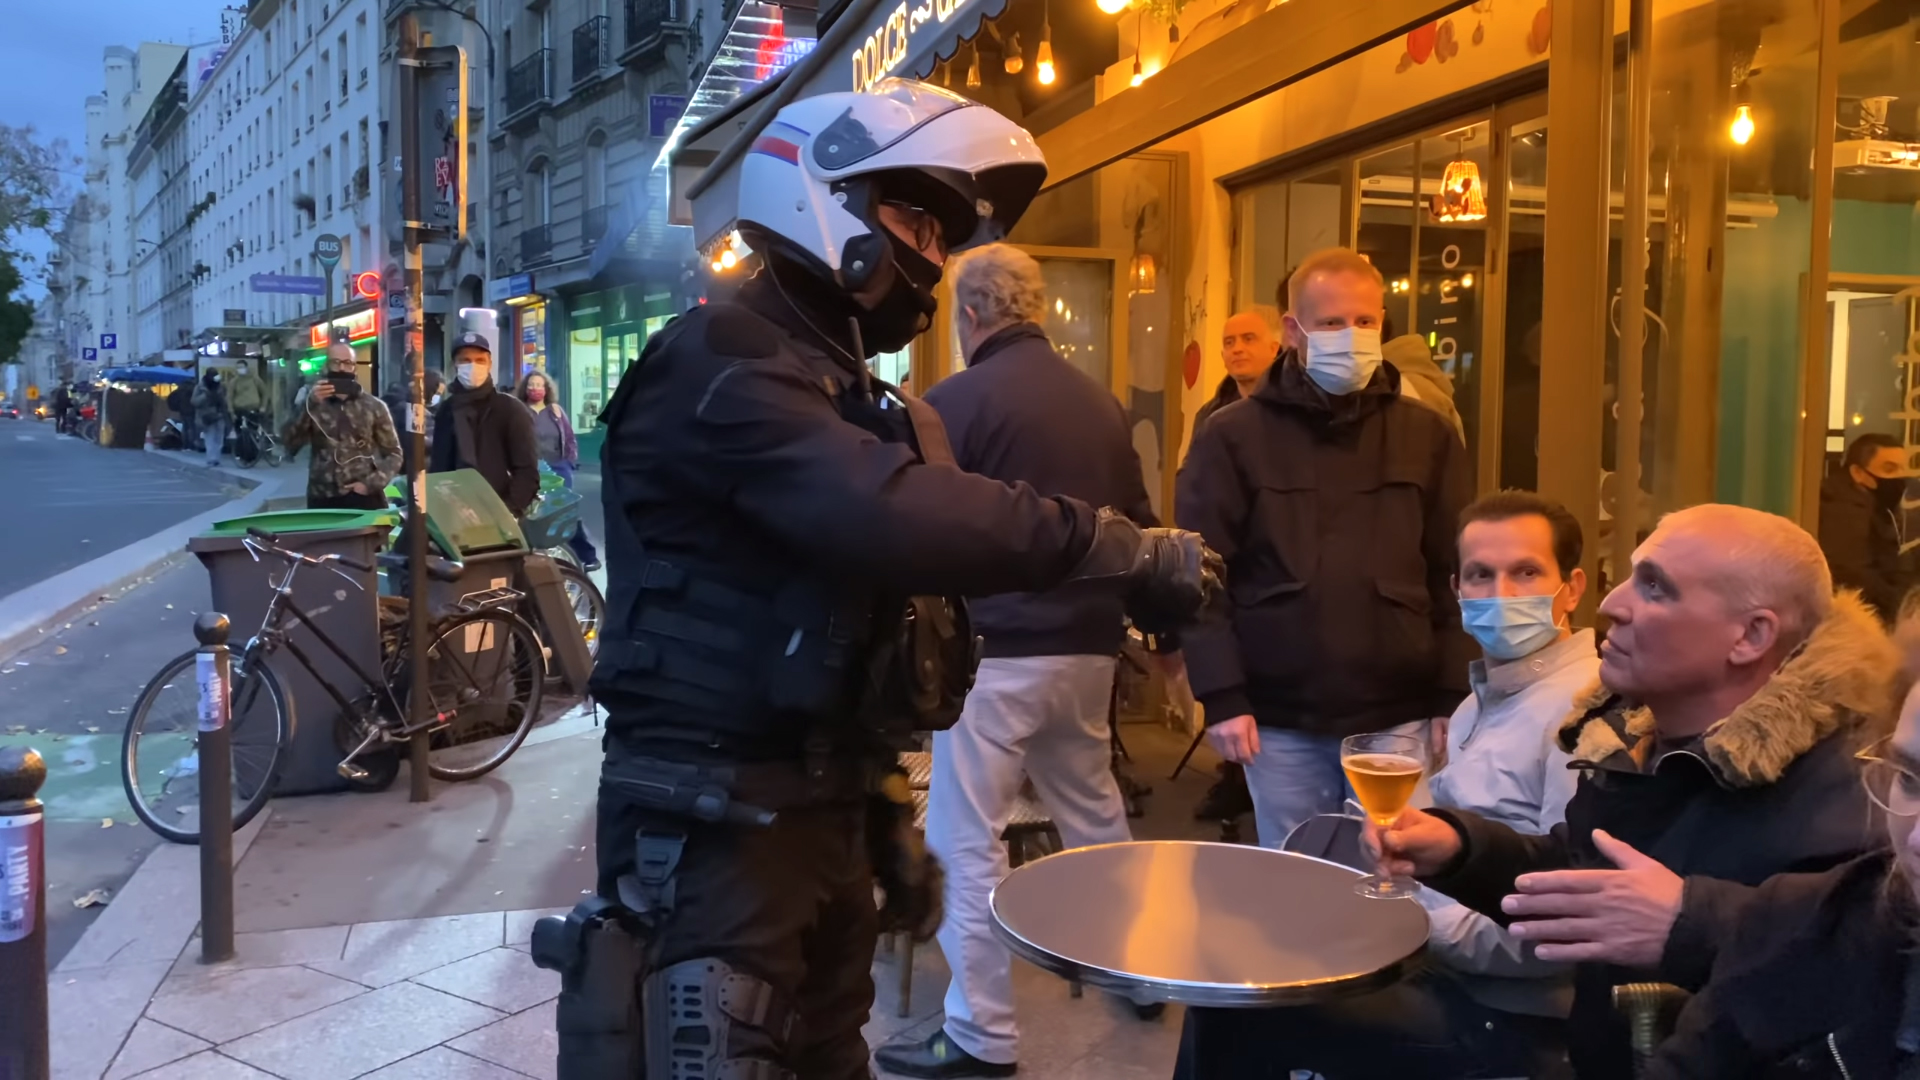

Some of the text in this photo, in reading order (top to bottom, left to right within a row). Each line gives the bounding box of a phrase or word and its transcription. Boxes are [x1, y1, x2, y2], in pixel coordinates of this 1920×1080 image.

[852, 1, 907, 93] DOLCE
[318, 240, 339, 252] BUS
[1432, 244, 1460, 378] bino
[104, 336, 113, 347] P
[85, 349, 94, 359] P
